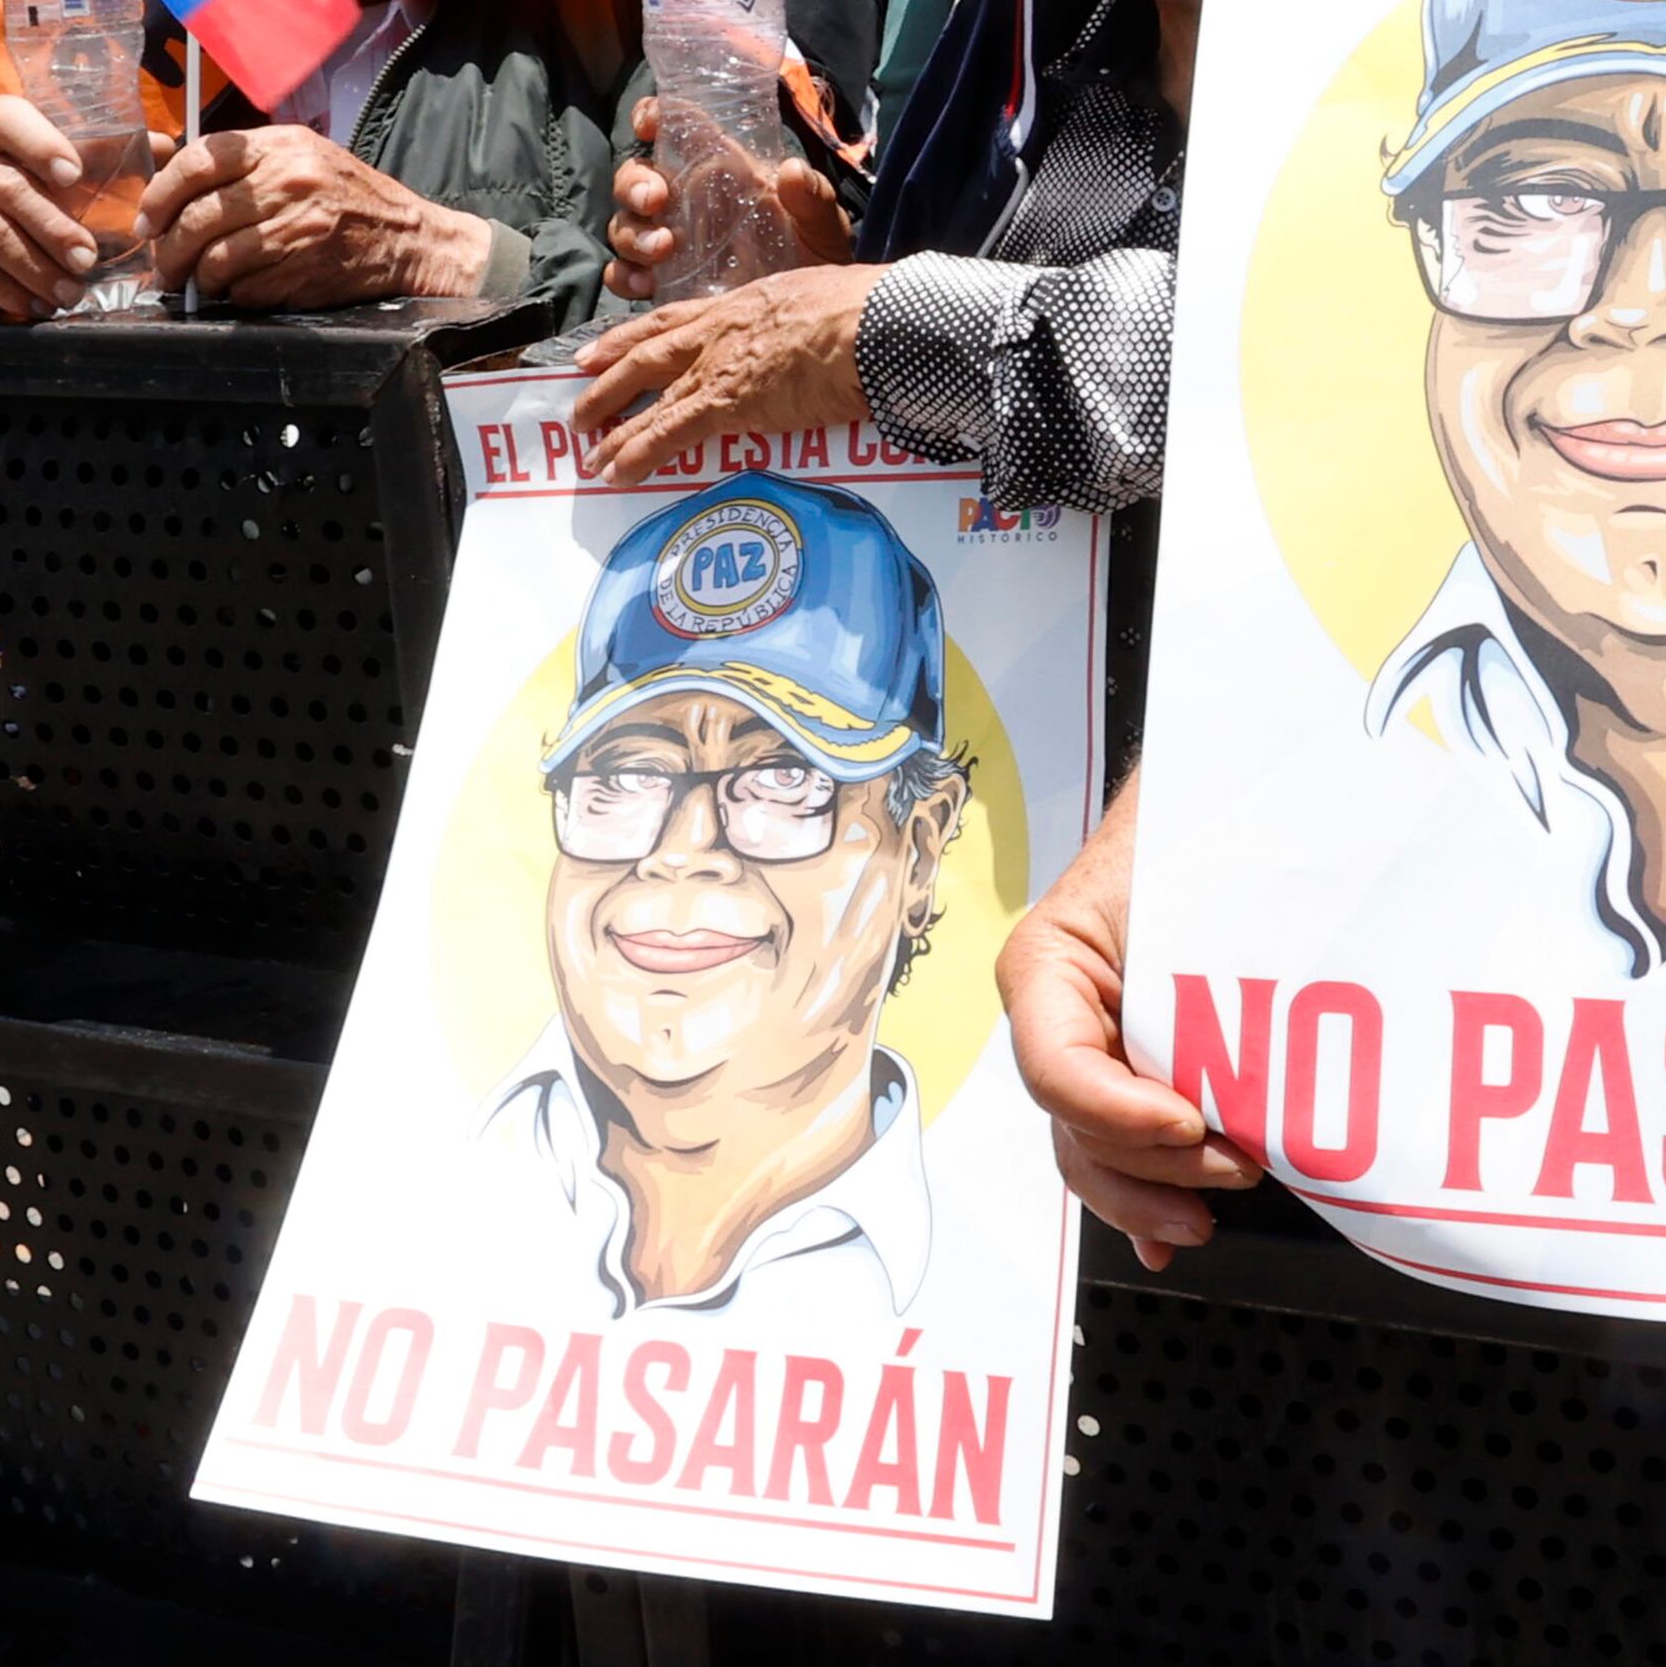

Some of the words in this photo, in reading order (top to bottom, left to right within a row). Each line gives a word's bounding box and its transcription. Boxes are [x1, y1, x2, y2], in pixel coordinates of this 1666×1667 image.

[477, 423, 531, 484] EL
[670, 506, 794, 557] PRESIDENCIA
[659, 577, 675, 606] DE
[692, 542, 766, 592] PAZ
[666, 603, 687, 627] LA
[692, 564, 798, 633] REPÚBLICA
[1171, 972, 1384, 1183] NO
[253, 1294, 436, 1447] NO
[451, 1328, 1015, 1527] PASARÁN
